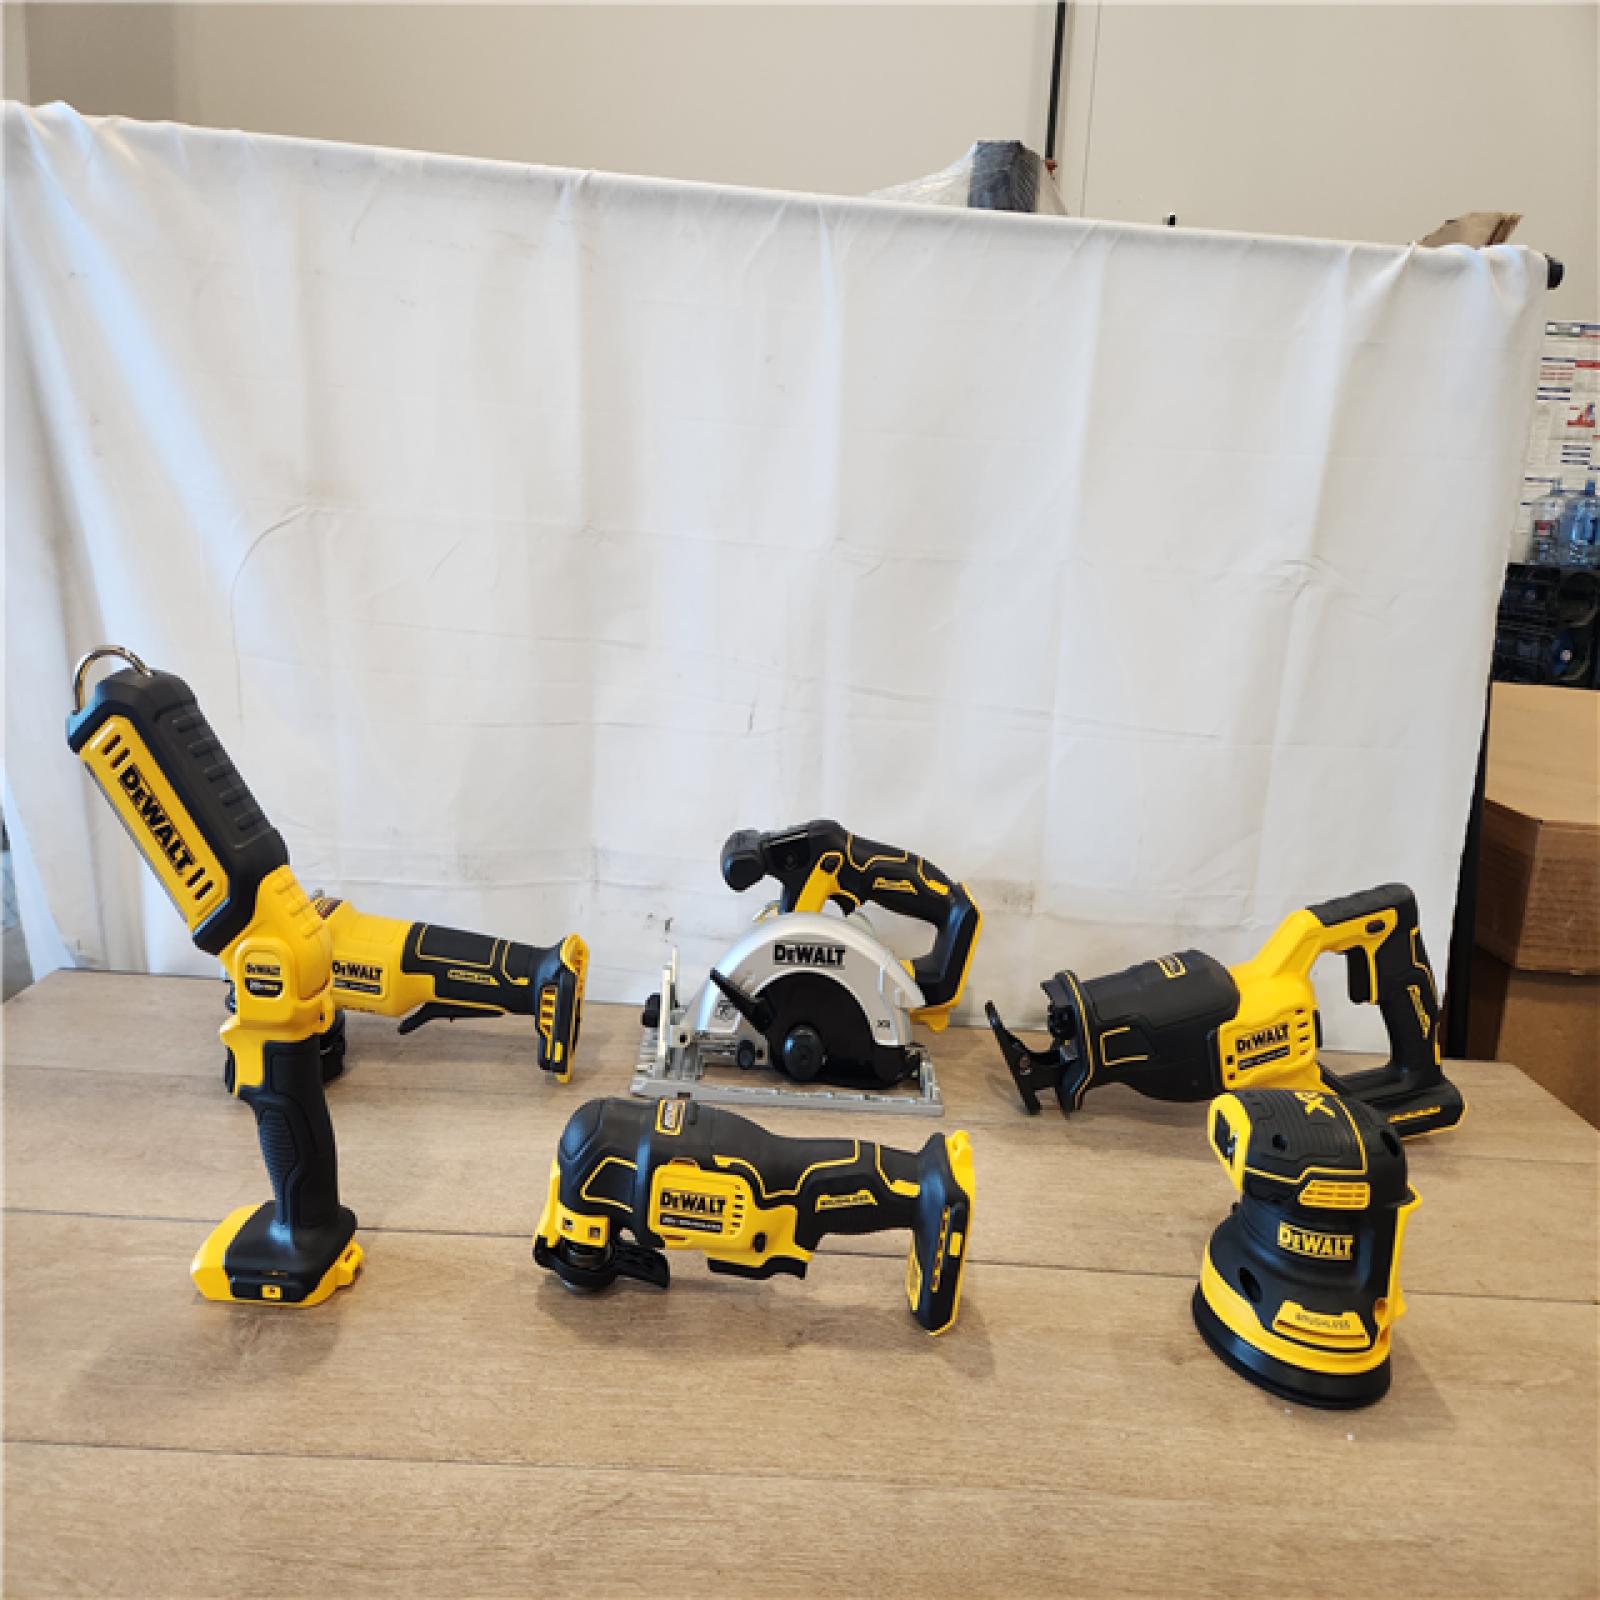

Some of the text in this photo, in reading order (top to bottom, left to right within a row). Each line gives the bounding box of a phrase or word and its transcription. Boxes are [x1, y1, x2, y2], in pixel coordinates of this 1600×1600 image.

[119, 763, 196, 874] DEWALT
[774, 942, 845, 968] DEWALT
[332, 960, 383, 981] DEWALT
[1236, 1023, 1289, 1054] DEWALT
[660, 1188, 727, 1214] DEWALT
[1277, 1220, 1354, 1261] DEWALT
